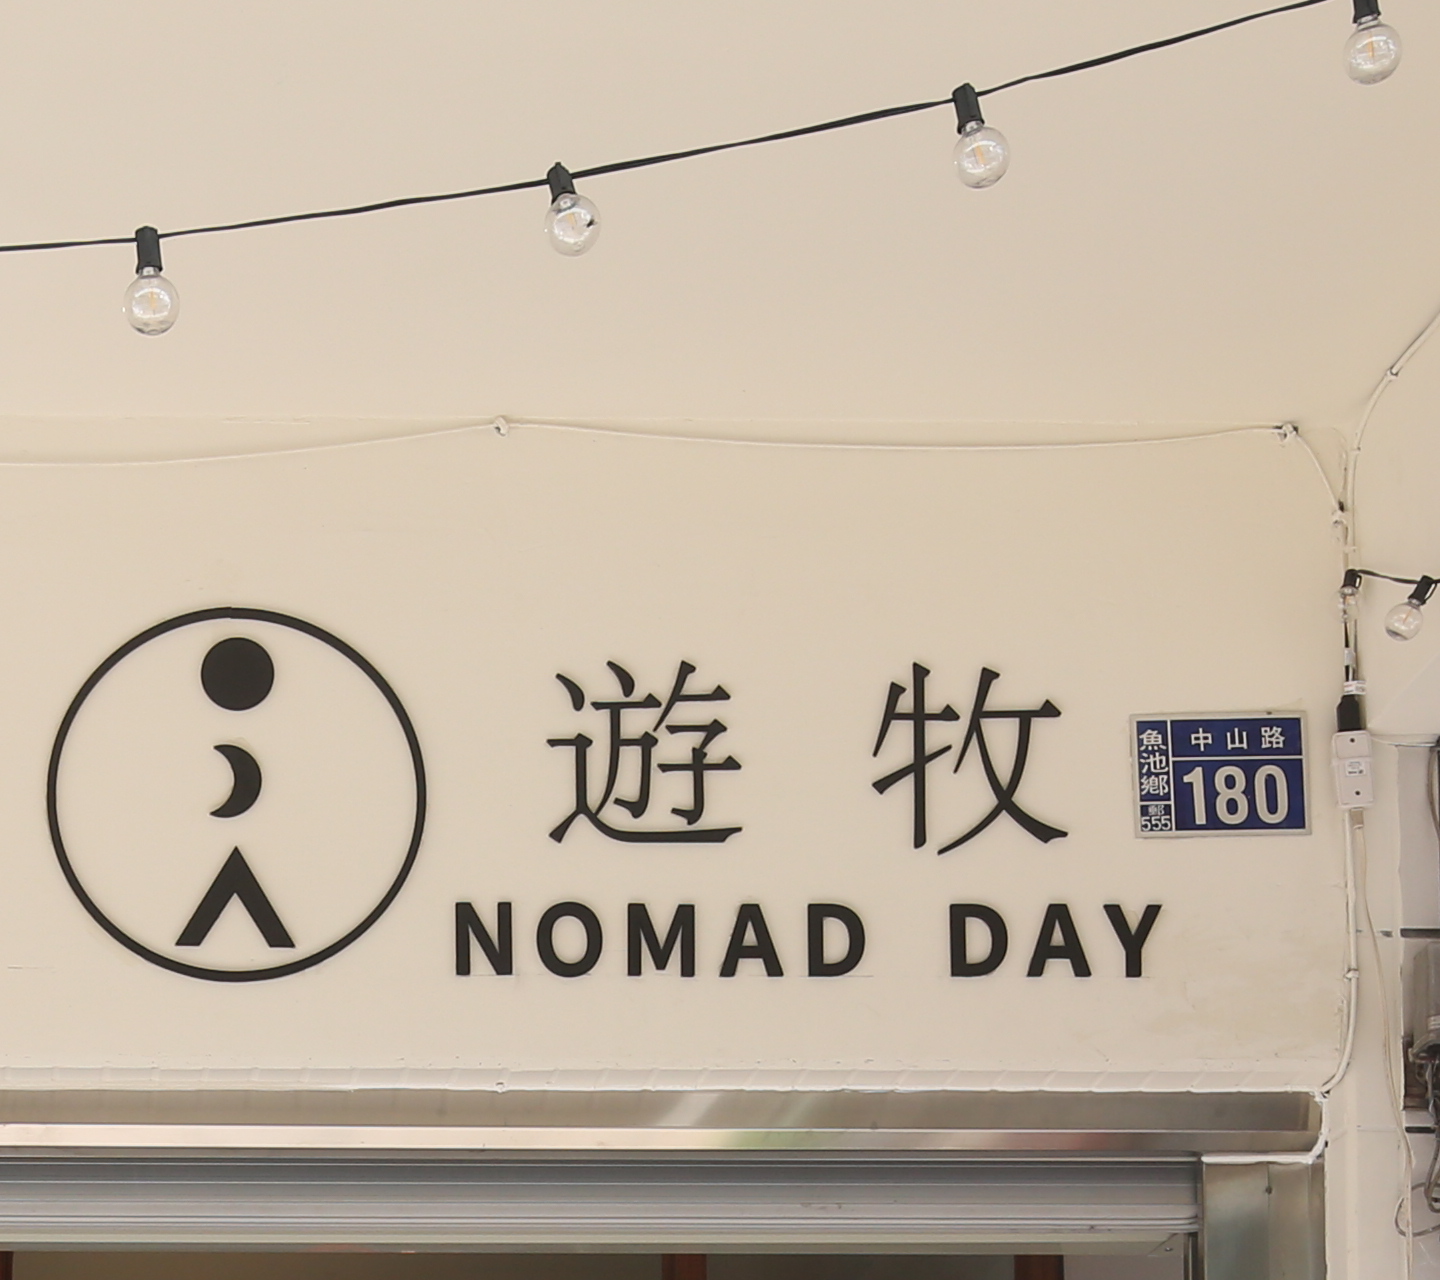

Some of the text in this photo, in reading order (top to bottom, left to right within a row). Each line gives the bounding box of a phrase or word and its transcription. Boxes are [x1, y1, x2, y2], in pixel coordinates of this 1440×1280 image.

[547, 659, 1070, 856] 遊牧
[1138, 728, 1170, 797] 魚池鄉
[1190, 725, 1286, 752] 中山路
[1140, 815, 1172, 832] 555
[1182, 764, 1289, 826] 180
[453, 899, 1164, 980] NOMAD DAY
